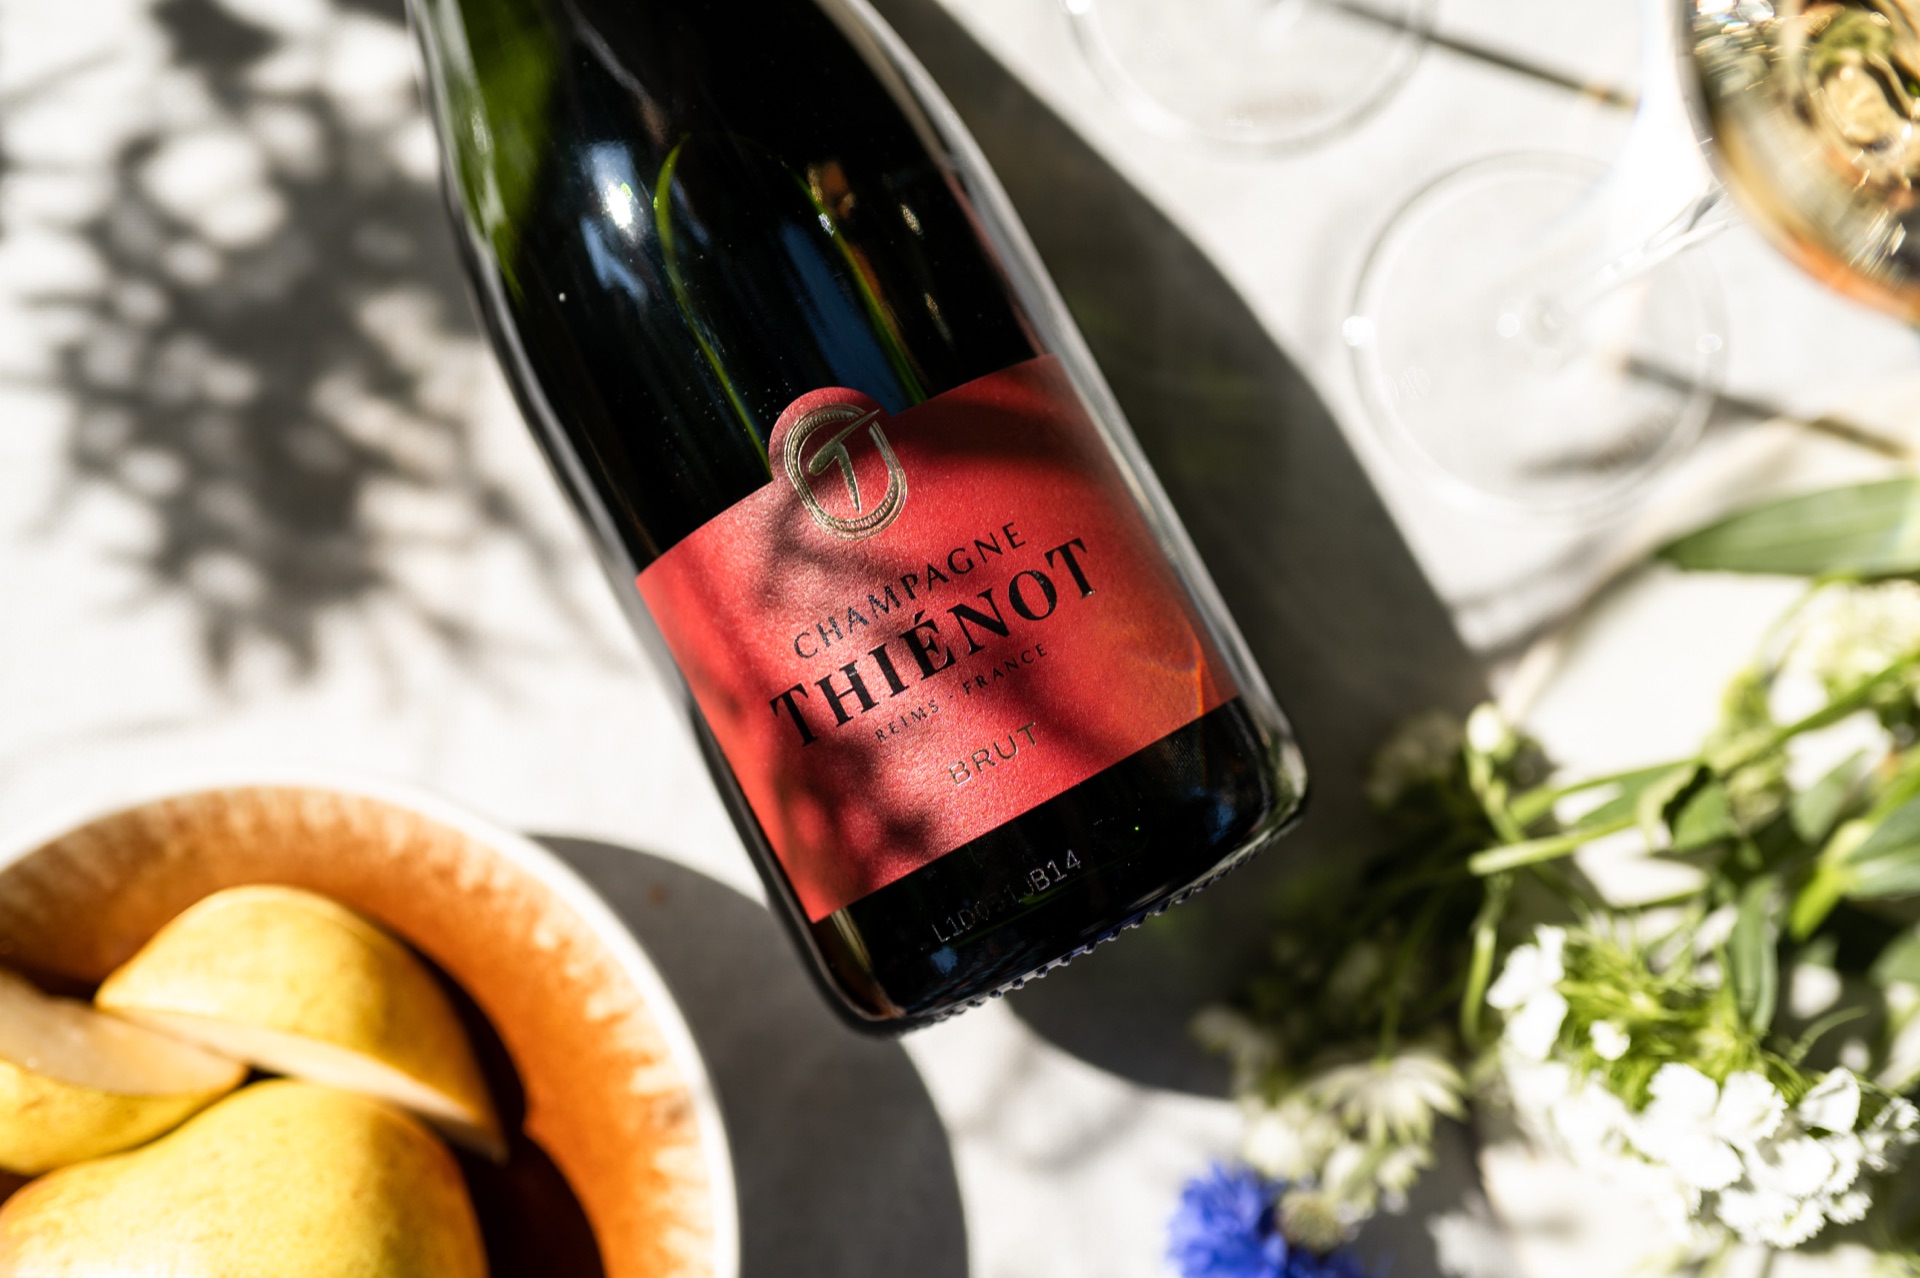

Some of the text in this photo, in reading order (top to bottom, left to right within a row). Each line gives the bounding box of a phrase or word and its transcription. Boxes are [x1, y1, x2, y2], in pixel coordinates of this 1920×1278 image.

[769, 537, 1097, 747] THIÉNOT
[793, 522, 1027, 660] CHAMPAGNE
[875, 699, 941, 742] REIMS
[962, 643, 1048, 695] FRANCE
[948, 721, 1037, 786] BRUT
